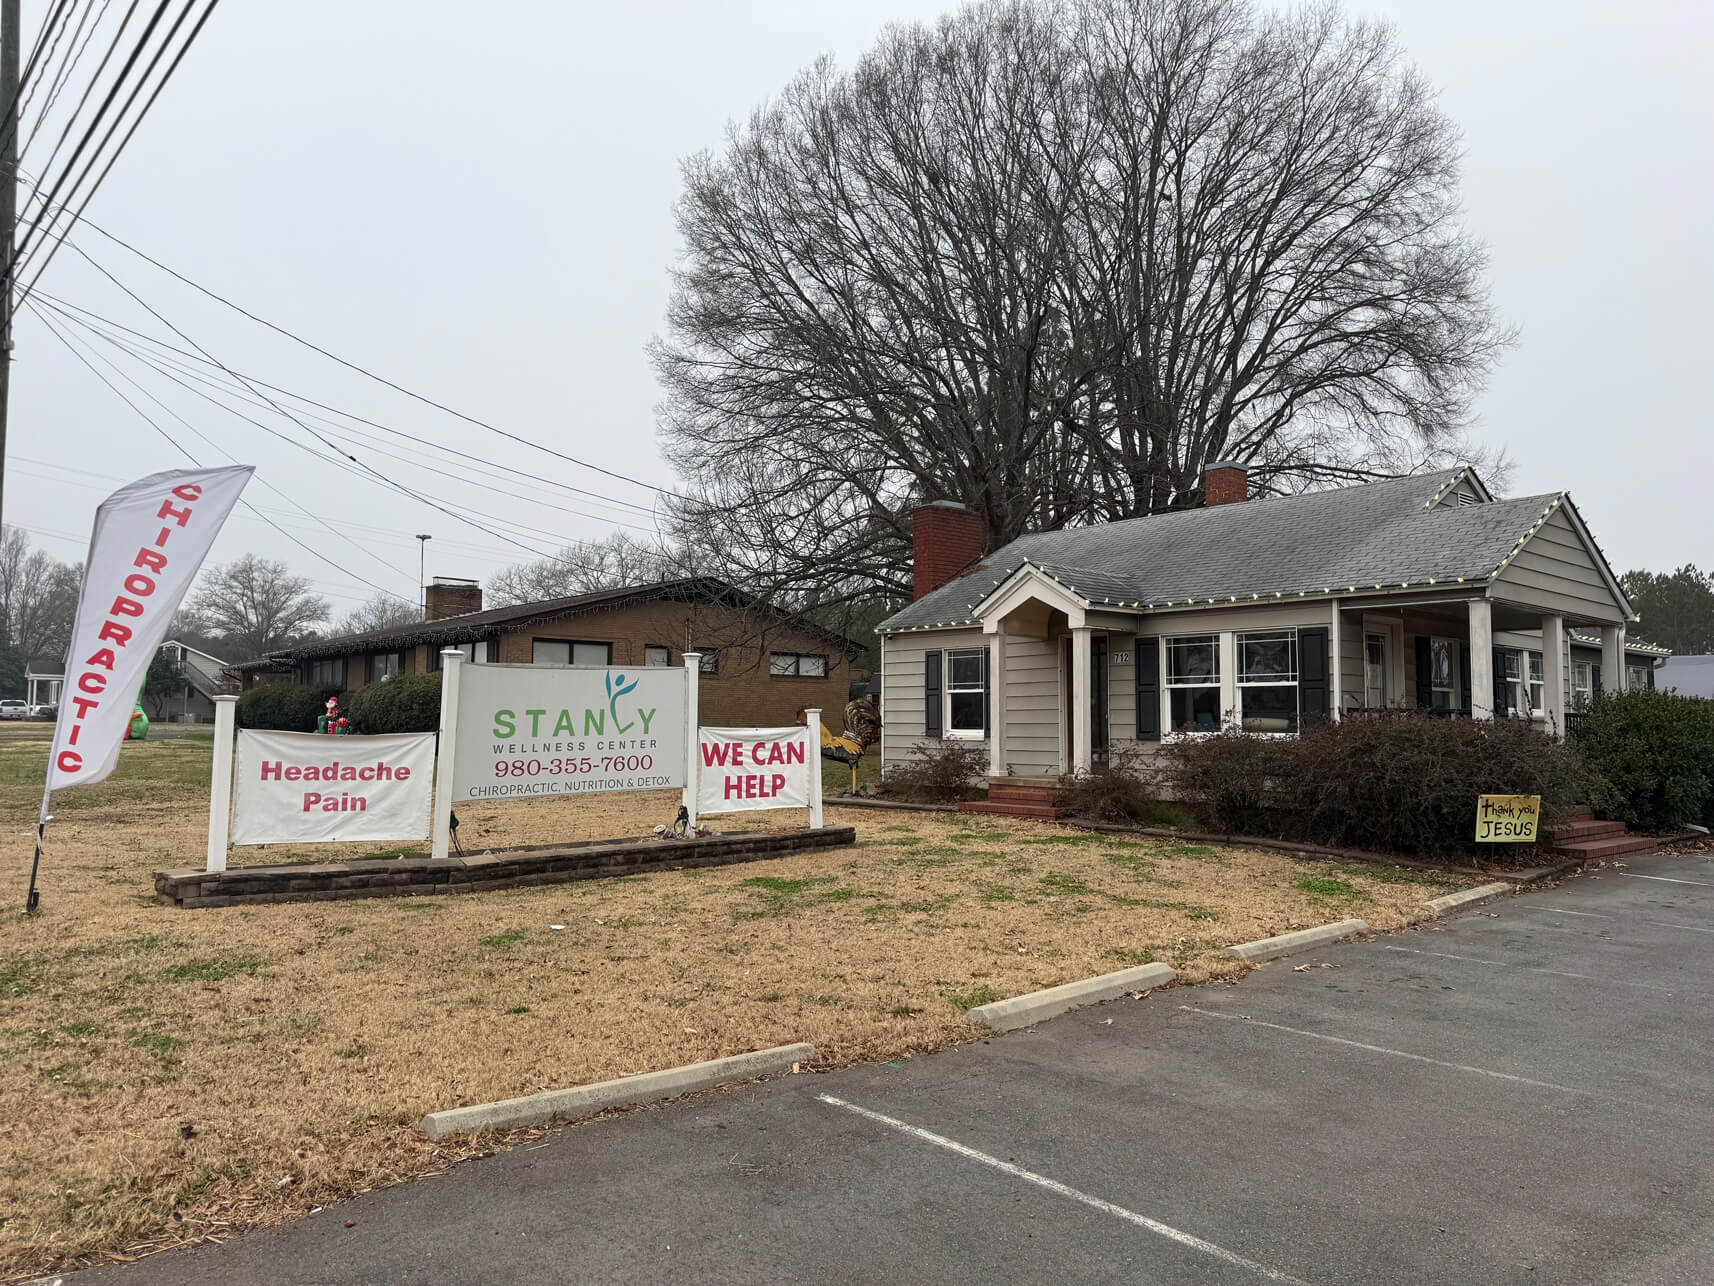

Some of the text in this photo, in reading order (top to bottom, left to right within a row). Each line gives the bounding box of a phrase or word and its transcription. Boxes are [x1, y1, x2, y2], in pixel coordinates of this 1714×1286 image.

[57, 484, 202, 773] CHIROPRACTIC
[1114, 652, 1129, 663] 712
[492, 705, 658, 739] STANLY
[493, 739, 657, 754] WELLNESS CENTER
[701, 741, 805, 767] WE CAN
[260, 760, 411, 781] Headache
[495, 754, 653, 778] 980-355-7600
[469, 775, 671, 798] CHIROPRACTIC, NUTRITION & DETOX
[724, 773, 786, 800] HELP
[303, 792, 367, 812] Pain
[1518, 804, 1535, 820] you
[1480, 821, 1534, 838] JESUS
